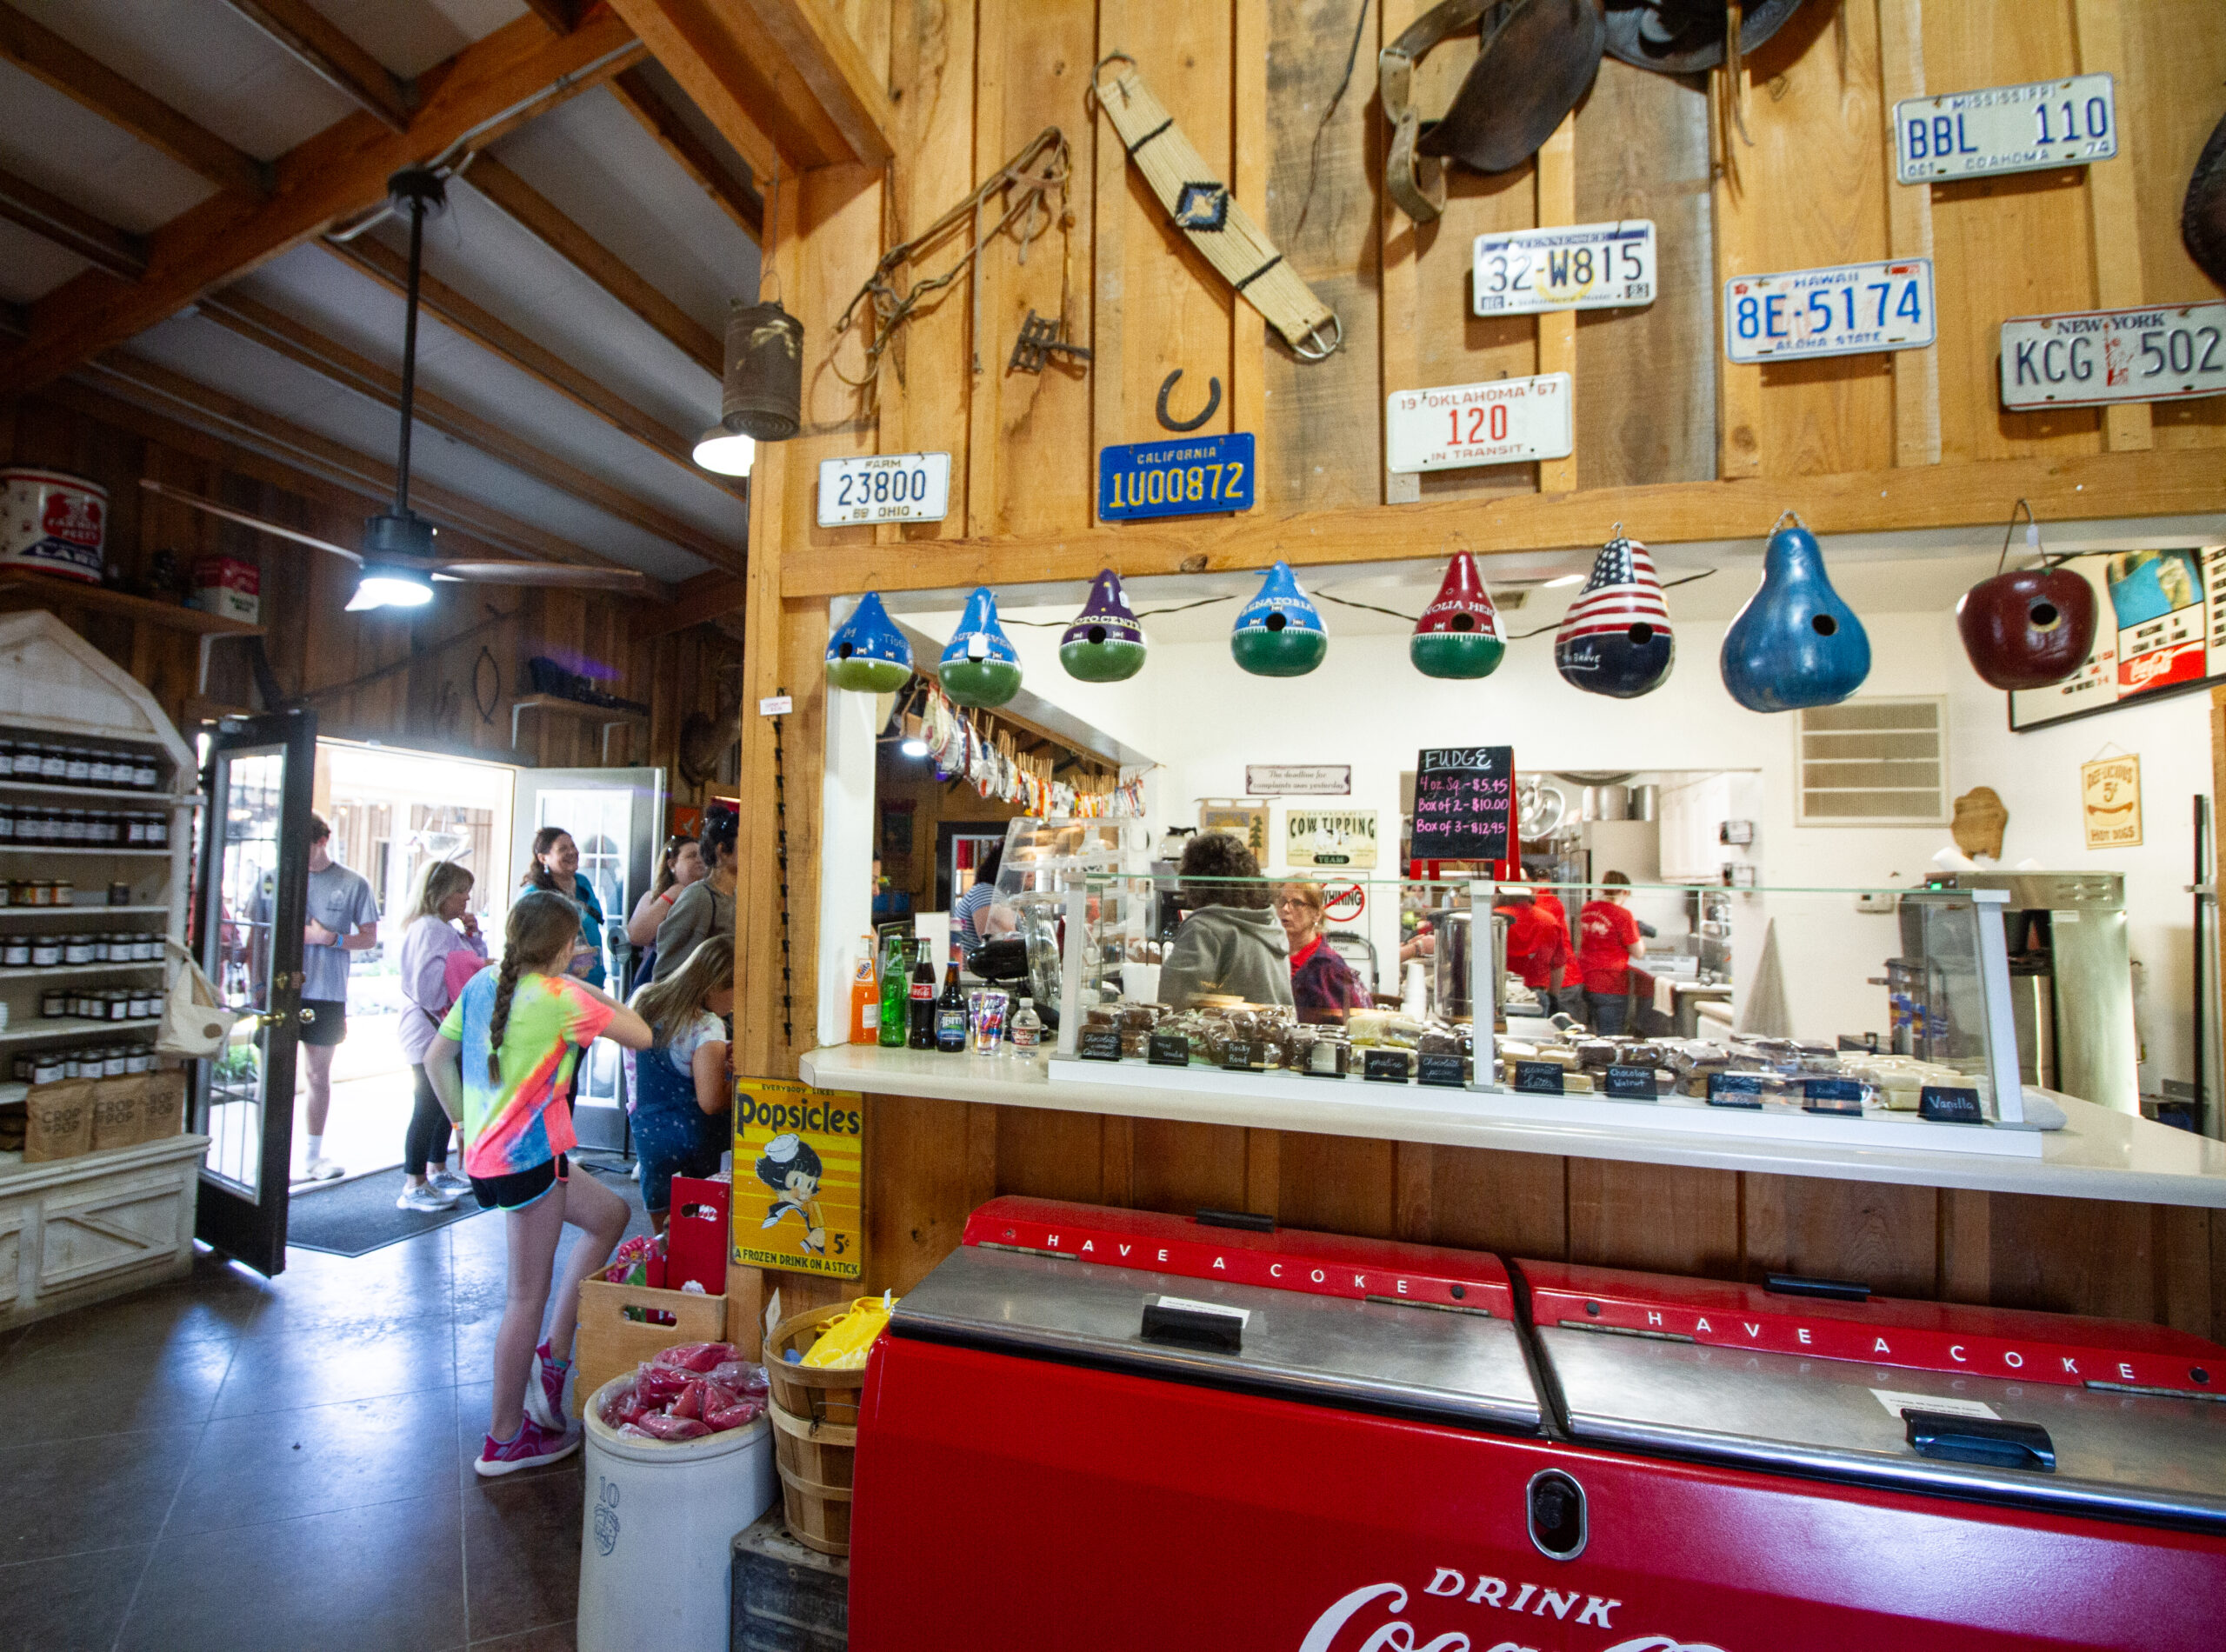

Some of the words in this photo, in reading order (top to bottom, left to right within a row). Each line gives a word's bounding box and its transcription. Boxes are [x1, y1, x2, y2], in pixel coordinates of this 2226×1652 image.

[1950, 87, 2055, 110] MISSISSIPPI
[1908, 113, 1978, 160] BBL
[2032, 97, 2108, 146] 110
[1965, 150, 2049, 170] COAHOMA
[1488, 242, 1643, 292] 32-W815
[1795, 271, 1860, 288] HAWAII
[1737, 280, 1921, 339] 8E-5174
[2056, 317, 2103, 335] NEW
[2110, 312, 2165, 330] YORK
[1776, 336, 1828, 350] ALOHA
[1836, 330, 1883, 345] STATE
[2016, 336, 2093, 385] KCG
[2140, 325, 2224, 377] 502
[1401, 398, 1417, 410] 19
[1429, 387, 1526, 408] OKLAHOMA
[1446, 403, 1508, 446] 120
[1136, 446, 1217, 465] CALIFORNIA
[1431, 451, 1446, 461] IN
[1454, 443, 1524, 460] TRANSIT
[865, 459, 902, 470] FARM
[837, 470, 926, 507] 23800
[877, 505, 910, 518] OHIO
[1425, 749, 1492, 769] FUDGE
[1269, 769, 1283, 779] The
[1283, 769, 1315, 779] deadline
[1316, 769, 1327, 780] for
[1420, 775, 1429, 791] 4
[1309, 781, 1344, 790] yesterday
[1418, 797, 1437, 813] Box
[1438, 797, 1451, 814] of
[1453, 799, 1463, 812] 2
[1290, 817, 1317, 839] COW
[1321, 817, 1375, 841] TIPPING
[1416, 818, 1437, 833] Box
[1439, 820, 1452, 837] of
[1454, 821, 1462, 833] 3
[2090, 829, 2110, 842] HOT
[2112, 825, 2136, 840] DOGS
[1317, 856, 1345, 864] TEAM
[856, 962, 871, 979] Fanta
[939, 1016, 964, 1029] ABITA
[1229, 1042, 1251, 1053] Rocky
[1229, 1054, 1248, 1064] Road
[1422, 1056, 1460, 1068] Chocolate
[1610, 1068, 1651, 1079] Chocolate
[761, 1083, 807, 1094] EVERYBODY
[812, 1087, 836, 1096] LIKES
[1614, 1079, 1646, 1088] Walnut
[94, 1098, 136, 1115] CROP
[1928, 1096, 1975, 1111] Vanilla
[736, 1092, 861, 1139] Popsicles
[735, 1249, 742, 1259] A
[743, 1249, 777, 1264] FROZEN
[779, 1255, 809, 1269] DRINK
[810, 1258, 823, 1270] ON
[1048, 1234, 1169, 1262] HAVE
[1212, 1256, 1226, 1269] A
[1270, 1263, 1408, 1295] COKE
[1648, 1311, 1812, 1345] HAVE
[1873, 1337, 1890, 1354] A
[1949, 1344, 2135, 1380] COKE
[1423, 1567, 1623, 1629] DRINK
